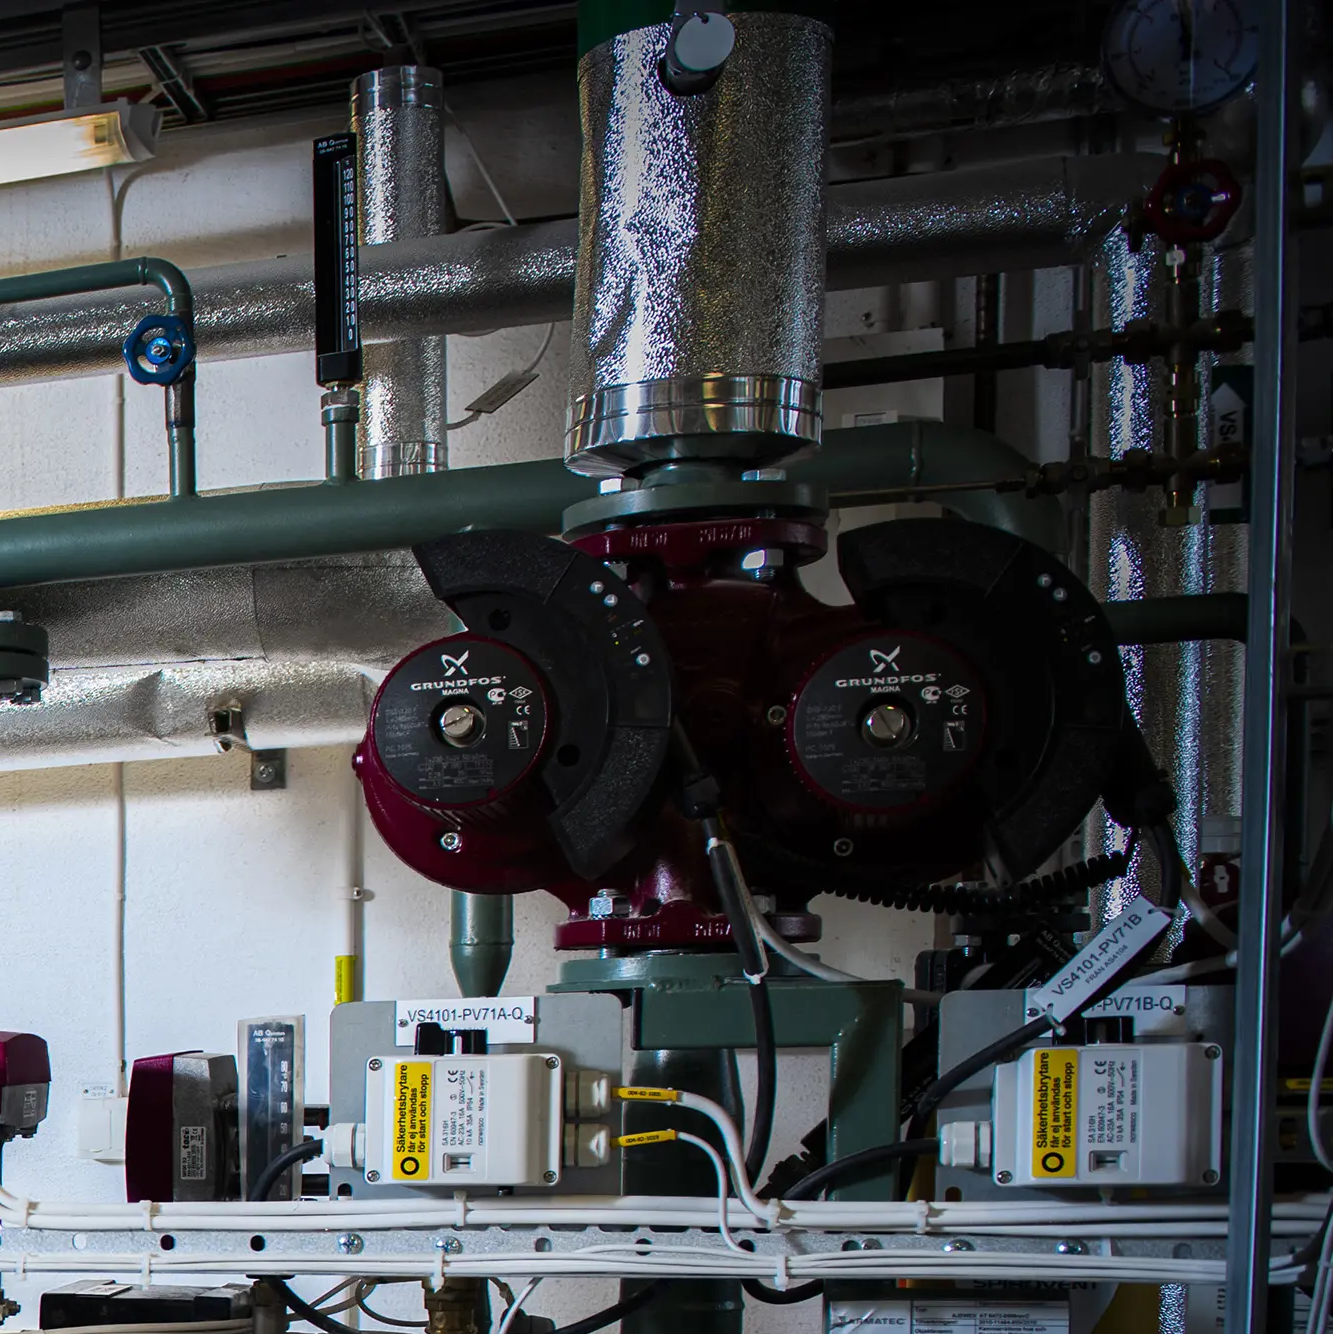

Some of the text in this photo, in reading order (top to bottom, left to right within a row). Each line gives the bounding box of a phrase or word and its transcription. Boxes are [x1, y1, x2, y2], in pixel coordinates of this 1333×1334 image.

[343, 168, 354, 180] 120
[343, 180, 354, 192] 110
[343, 193, 354, 205] 100
[345, 233, 354, 245] 70
[345, 259, 355, 273] 50
[345, 273, 355, 286] 40
[345, 287, 355, 299] 30
[345, 300, 355, 313] 20
[346, 314, 355, 326] 10
[410, 677, 503, 691] GRUNDFOS
[835, 673, 938, 688] GRUNDFOS
[441, 687, 470, 696] MAGNA
[869, 684, 901, 693] MAGNA
[1051, 914, 1142, 998] VS4101-PV71B
[407, 1006, 523, 1023] VS4101-PV71A-Q
[1036, 1052, 1051, 1149] Säkerhetsbrytare
[1062, 1061, 1075, 1149] för start och stopp
[396, 1065, 409, 1153] Säkerhetsbrytare
[418, 1074, 430, 1153] för start och stopp
[1050, 1077, 1062, 1149] får ej användas
[408, 1087, 418, 1153] får ej användas
